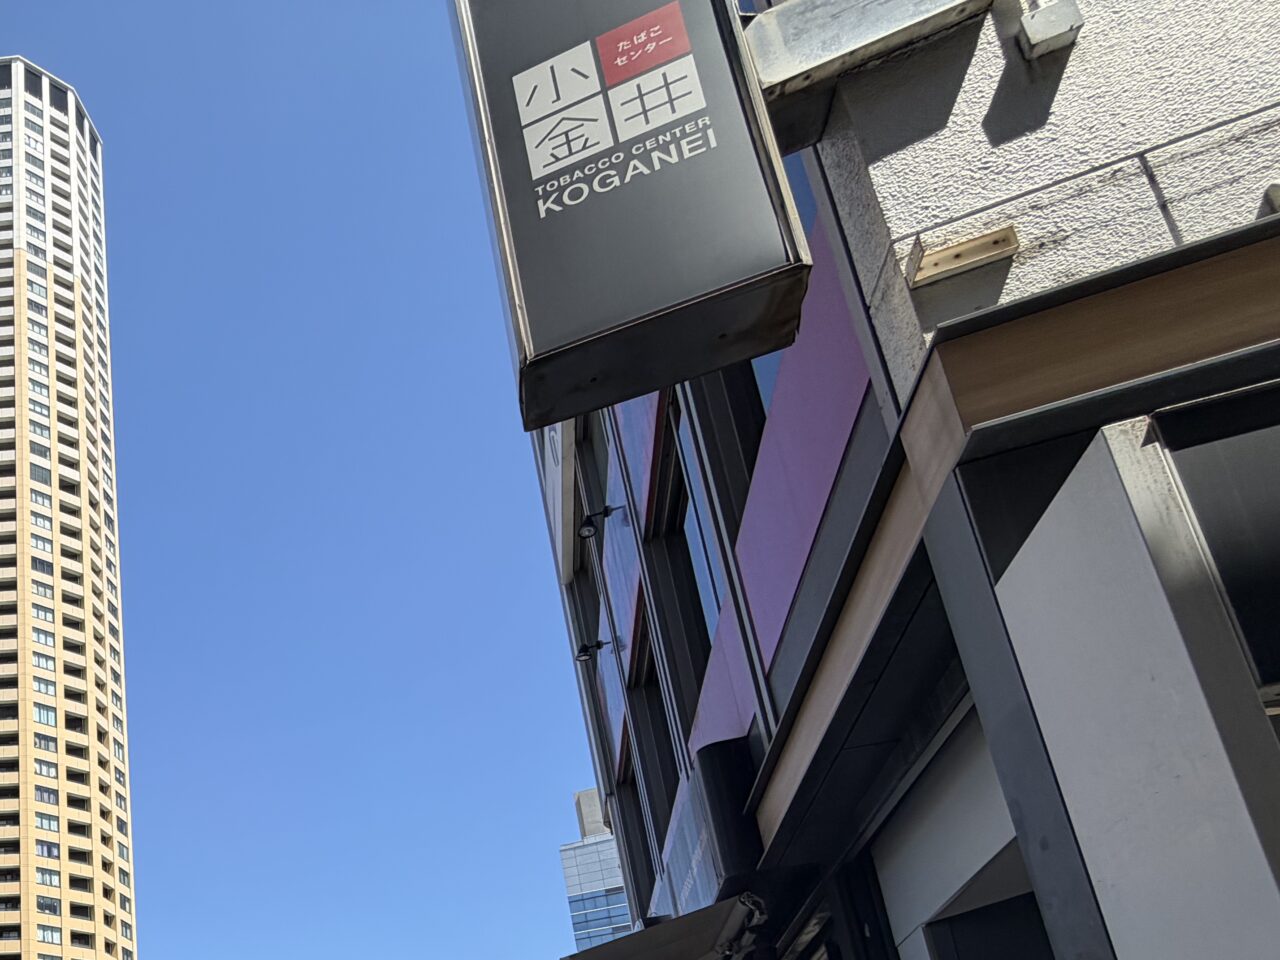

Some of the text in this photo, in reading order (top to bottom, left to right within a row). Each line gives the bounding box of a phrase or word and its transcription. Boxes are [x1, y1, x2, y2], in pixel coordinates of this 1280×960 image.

[613, 36, 673, 66] センター
[616, 25, 663, 52] たばこ
[534, 116, 712, 196] TOBACCO CENTER
[537, 129, 718, 219] KOGANEI
